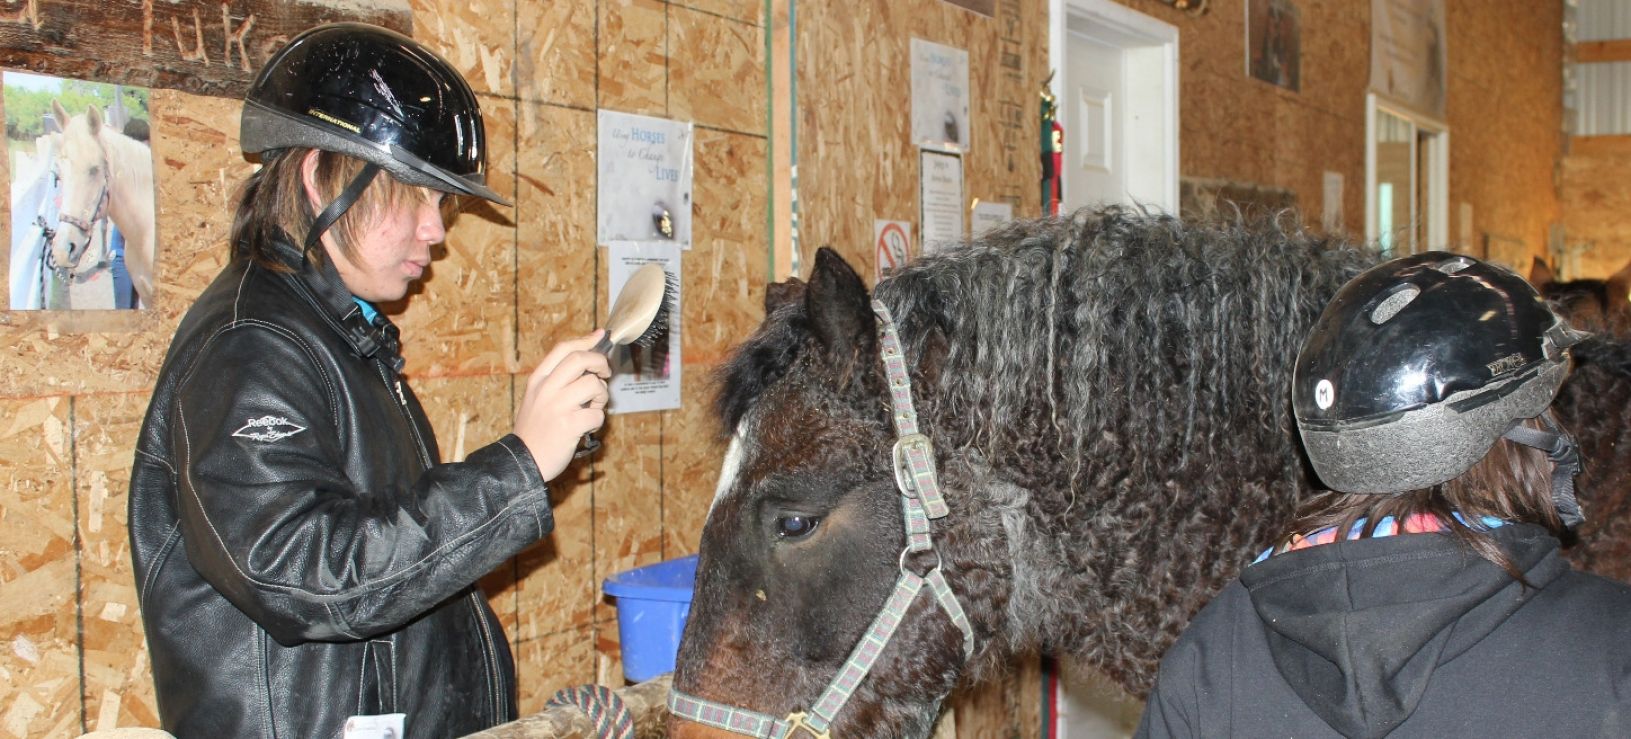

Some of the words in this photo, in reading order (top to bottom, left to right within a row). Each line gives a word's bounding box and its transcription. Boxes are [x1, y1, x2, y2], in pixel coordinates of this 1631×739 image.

[308, 109, 361, 134] INTERNATIONAL
[631, 127, 665, 144] HORSES
[627, 149, 636, 158] to
[656, 167, 678, 182] LIVES
[1319, 388, 1328, 402] M
[247, 416, 288, 428] Reebok
